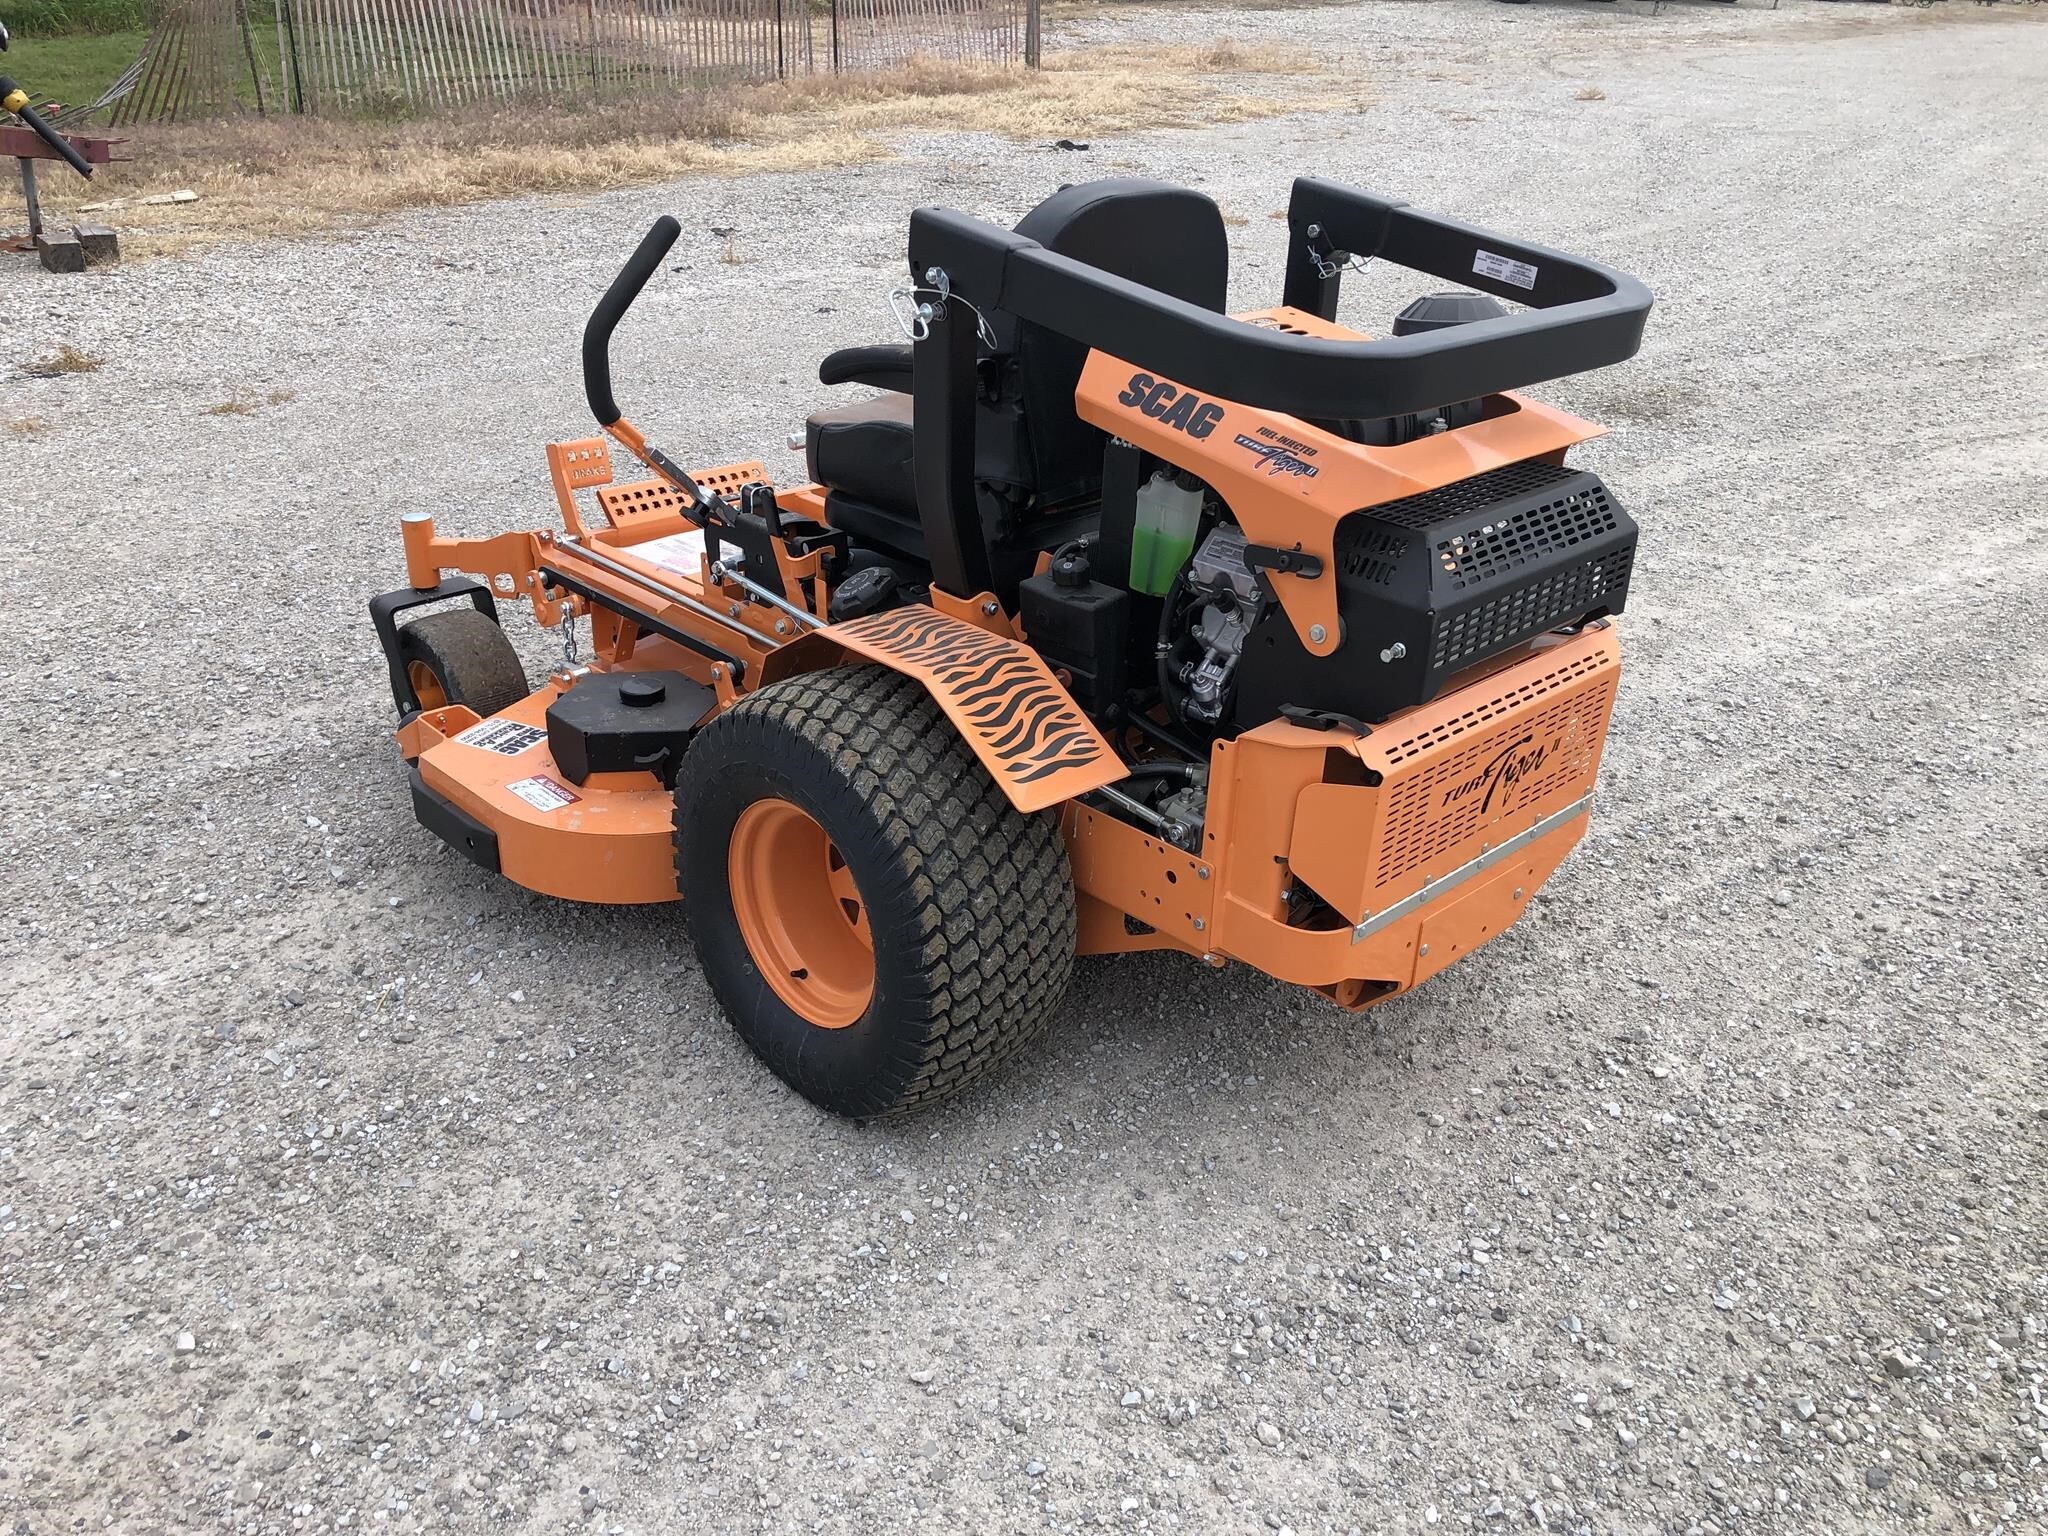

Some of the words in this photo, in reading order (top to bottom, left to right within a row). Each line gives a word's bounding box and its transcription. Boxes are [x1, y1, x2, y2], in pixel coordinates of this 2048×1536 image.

[1118, 373, 1225, 439] SCAG
[1237, 436, 1272, 454] TURF
[1256, 426, 1318, 456] FUEL-INJECTED
[1254, 446, 1304, 476] Tiger
[499, 729, 548, 754] SCAG
[1441, 767, 1497, 807] TURF
[1480, 734, 1549, 814] Tiger
[545, 781, 575, 800] DANGER
